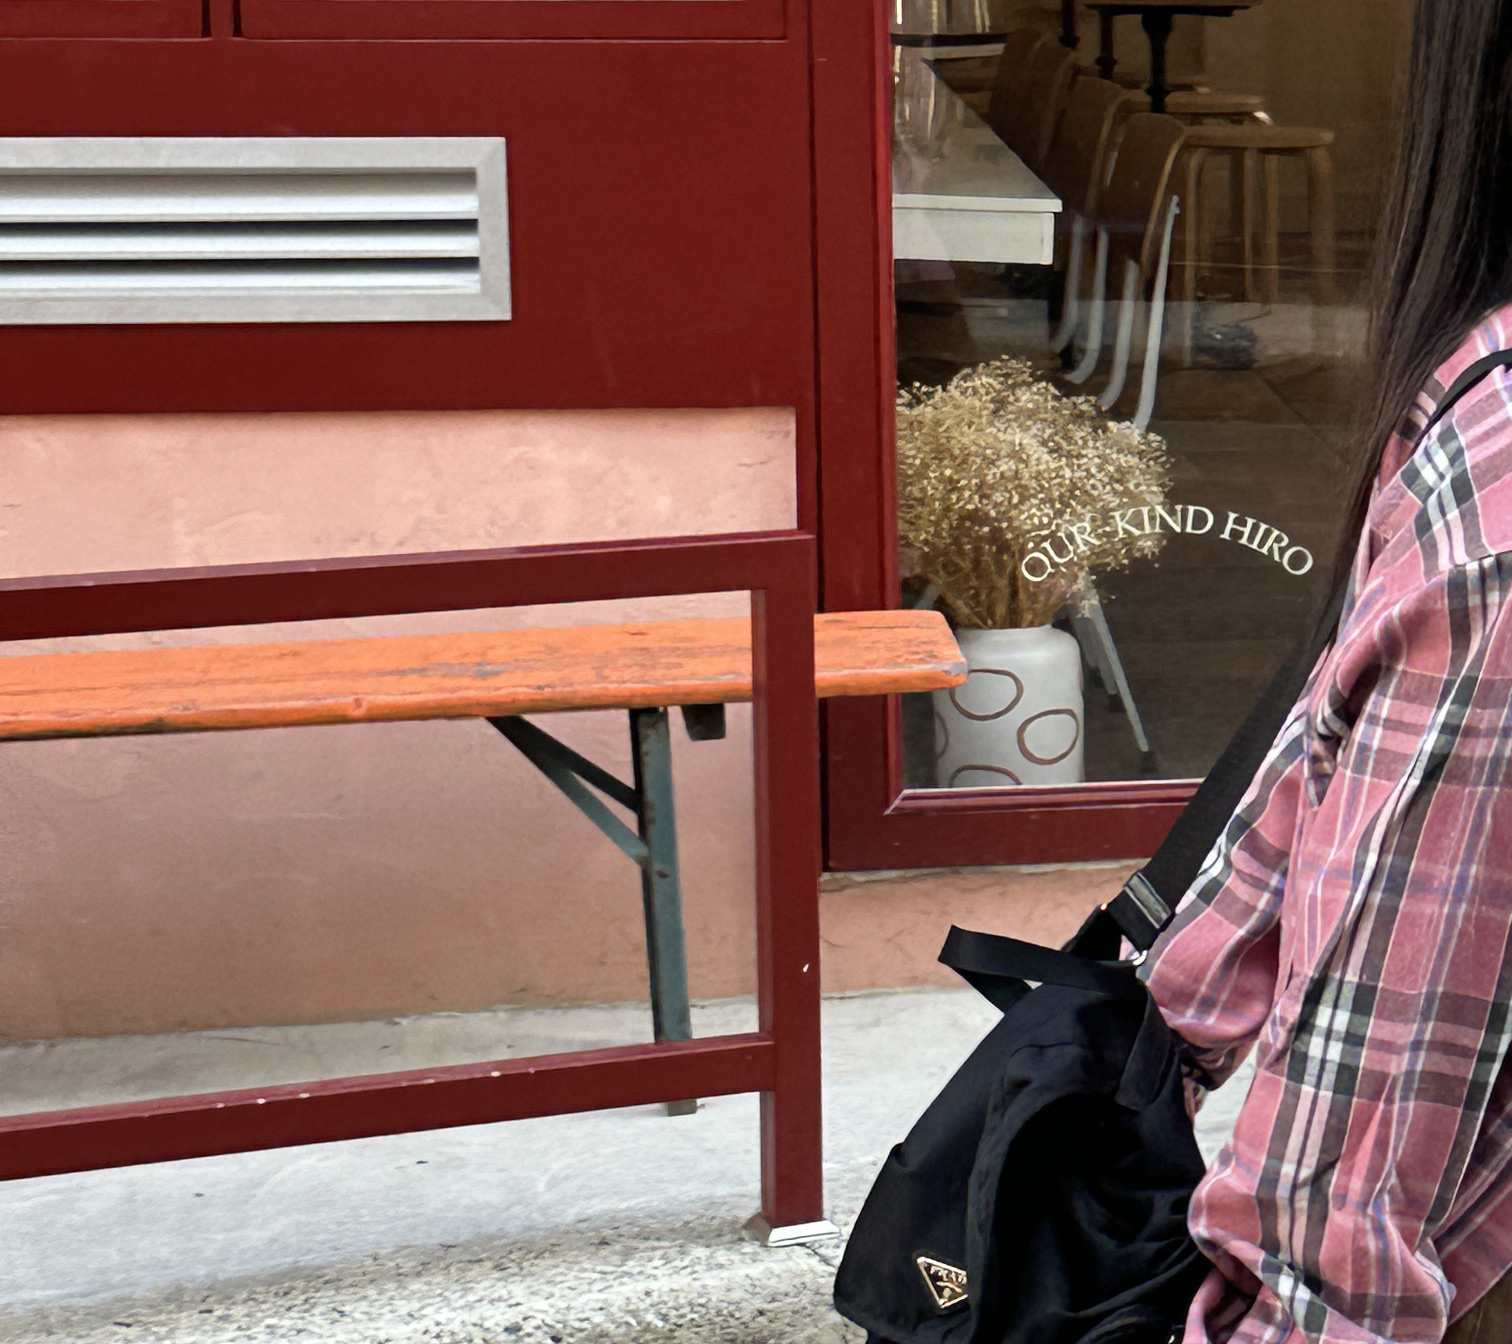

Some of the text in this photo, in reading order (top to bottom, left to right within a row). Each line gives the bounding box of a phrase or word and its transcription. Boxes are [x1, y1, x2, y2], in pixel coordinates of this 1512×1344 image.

[1020, 504, 1314, 583] OUR KIND HIRO
